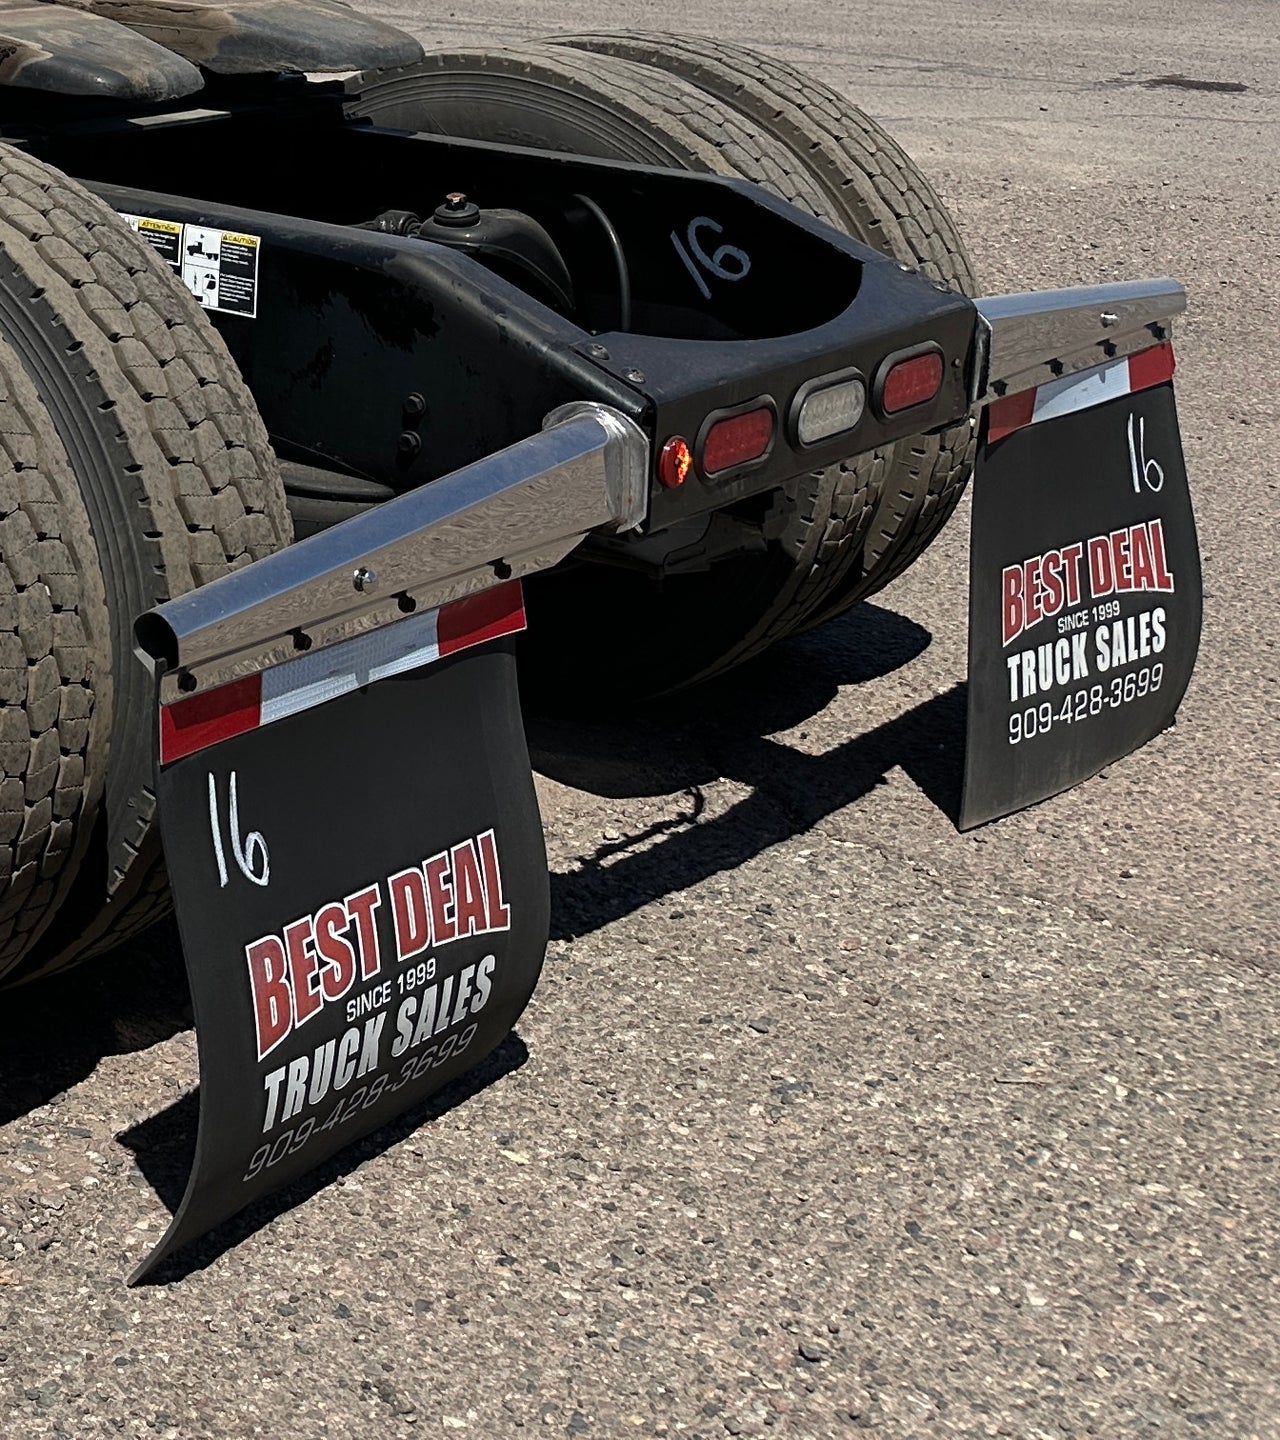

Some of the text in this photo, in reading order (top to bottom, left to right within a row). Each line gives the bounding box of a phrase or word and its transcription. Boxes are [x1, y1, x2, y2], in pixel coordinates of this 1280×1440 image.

[669, 216, 752, 300] 16
[1127, 412, 1164, 494] 16
[1001, 518, 1175, 648] BEST DEAL
[1057, 600, 1121, 635] SINCE 1999
[1007, 607, 1166, 703] TRUCK SALES
[1008, 663, 1164, 745] 909-428-3699
[207, 770, 270, 888] 16
[244, 828, 512, 1062] BEST DEAL
[346, 958, 438, 1024] SINCE 1999
[261, 954, 498, 1134] TRUCK SALES
[242, 1022, 479, 1183] 909-428-3699
